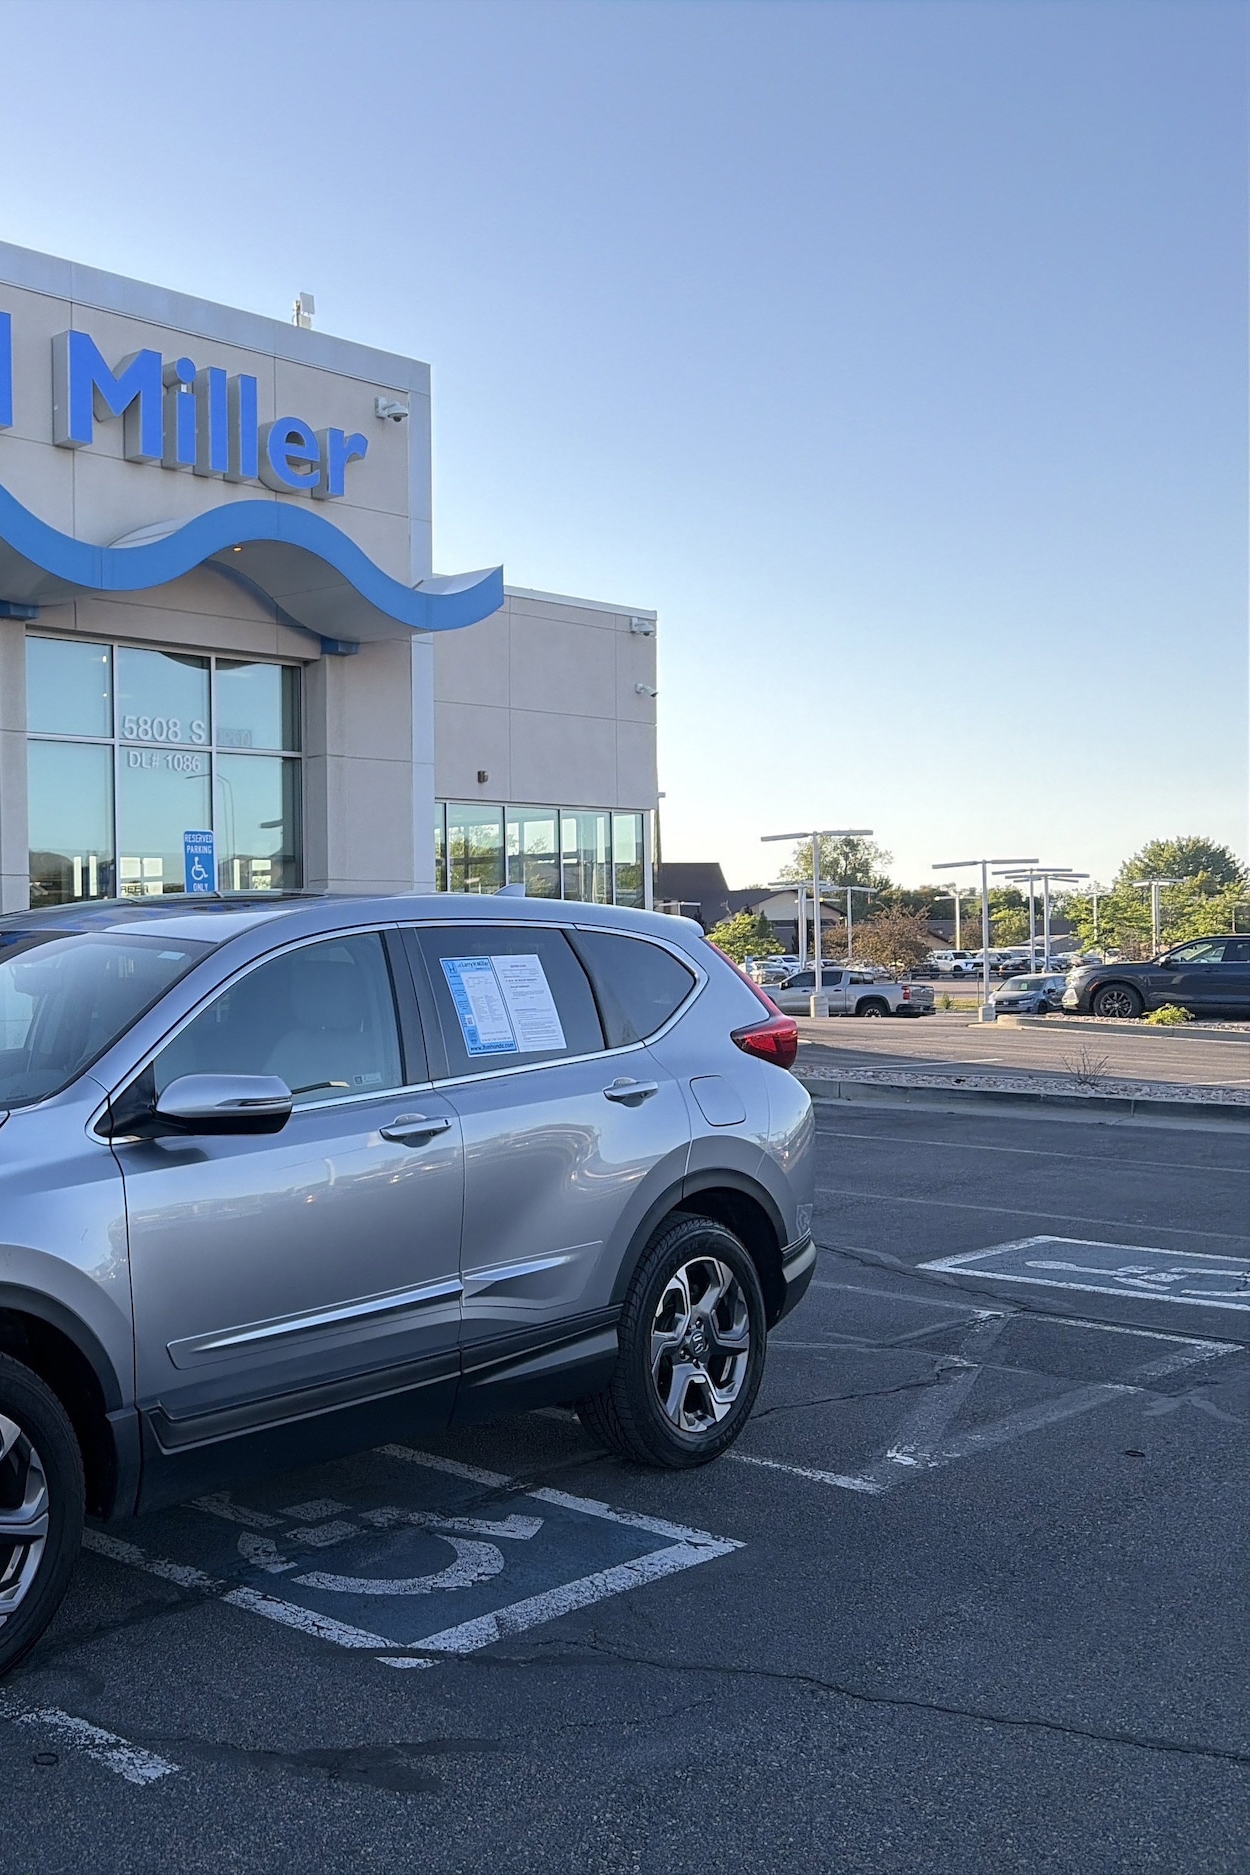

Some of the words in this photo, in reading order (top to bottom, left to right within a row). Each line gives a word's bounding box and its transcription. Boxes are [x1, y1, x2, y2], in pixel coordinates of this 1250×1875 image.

[52, 330, 369, 499] Miller
[123, 715, 181, 742] 5808
[190, 720, 205, 744] S
[128, 751, 159, 769] DL#
[164, 754, 201, 772] 1086
[184, 833, 213, 843] RESERVED
[186, 844, 212, 854] PARKING
[193, 882, 209, 892] ONLY
